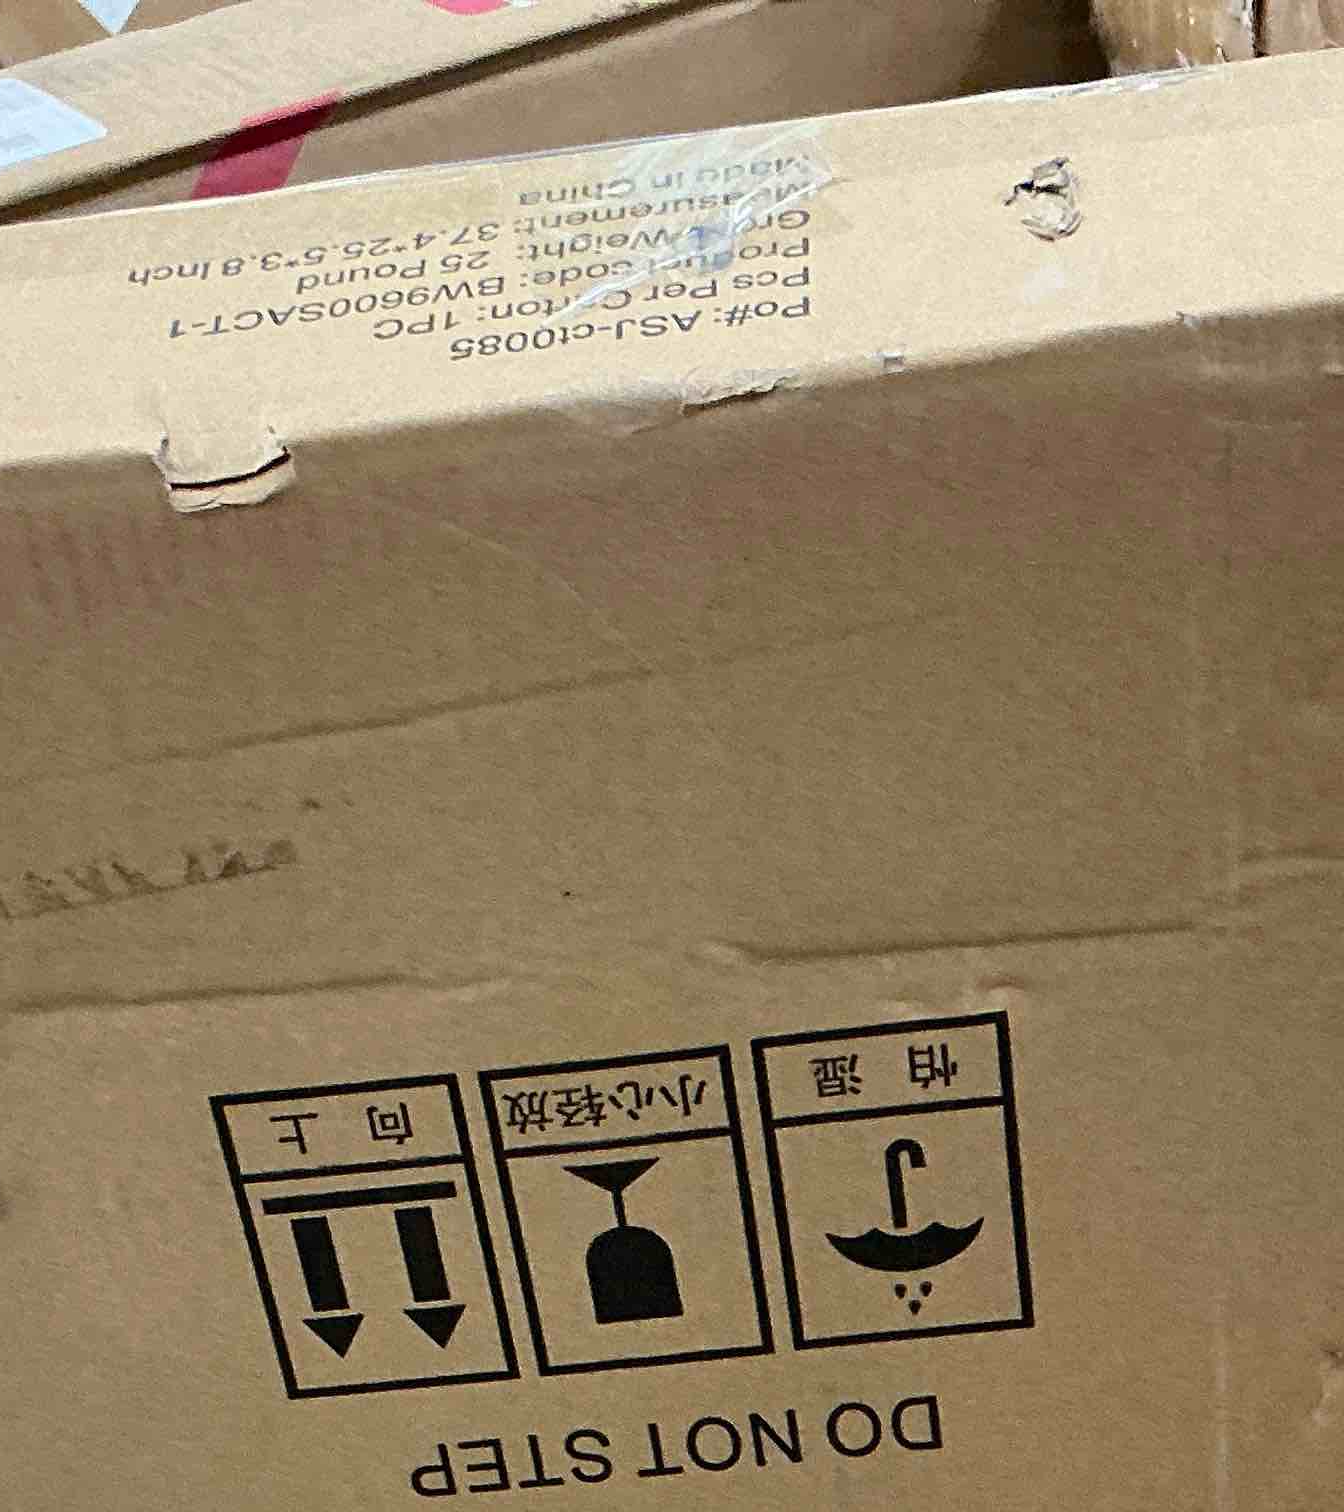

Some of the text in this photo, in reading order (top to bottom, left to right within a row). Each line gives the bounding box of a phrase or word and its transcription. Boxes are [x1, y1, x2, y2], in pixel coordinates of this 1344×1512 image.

[127, 260, 209, 287] Inch
[295, 258, 426, 295] Pound
[440, 249, 490, 274] 25
[167, 275, 506, 339] BW9600SACT-1
[372, 266, 810, 341] Pcs Per Crton: 1PC
[450, 296, 811, 361] Po#: ASJ-ct0085
[808, 1042, 958, 1100] 怕湿
[268, 1101, 414, 1154] 向上
[500, 1073, 706, 1135] 小心轻放
[411, 1394, 944, 1497] DO NOT STEP
